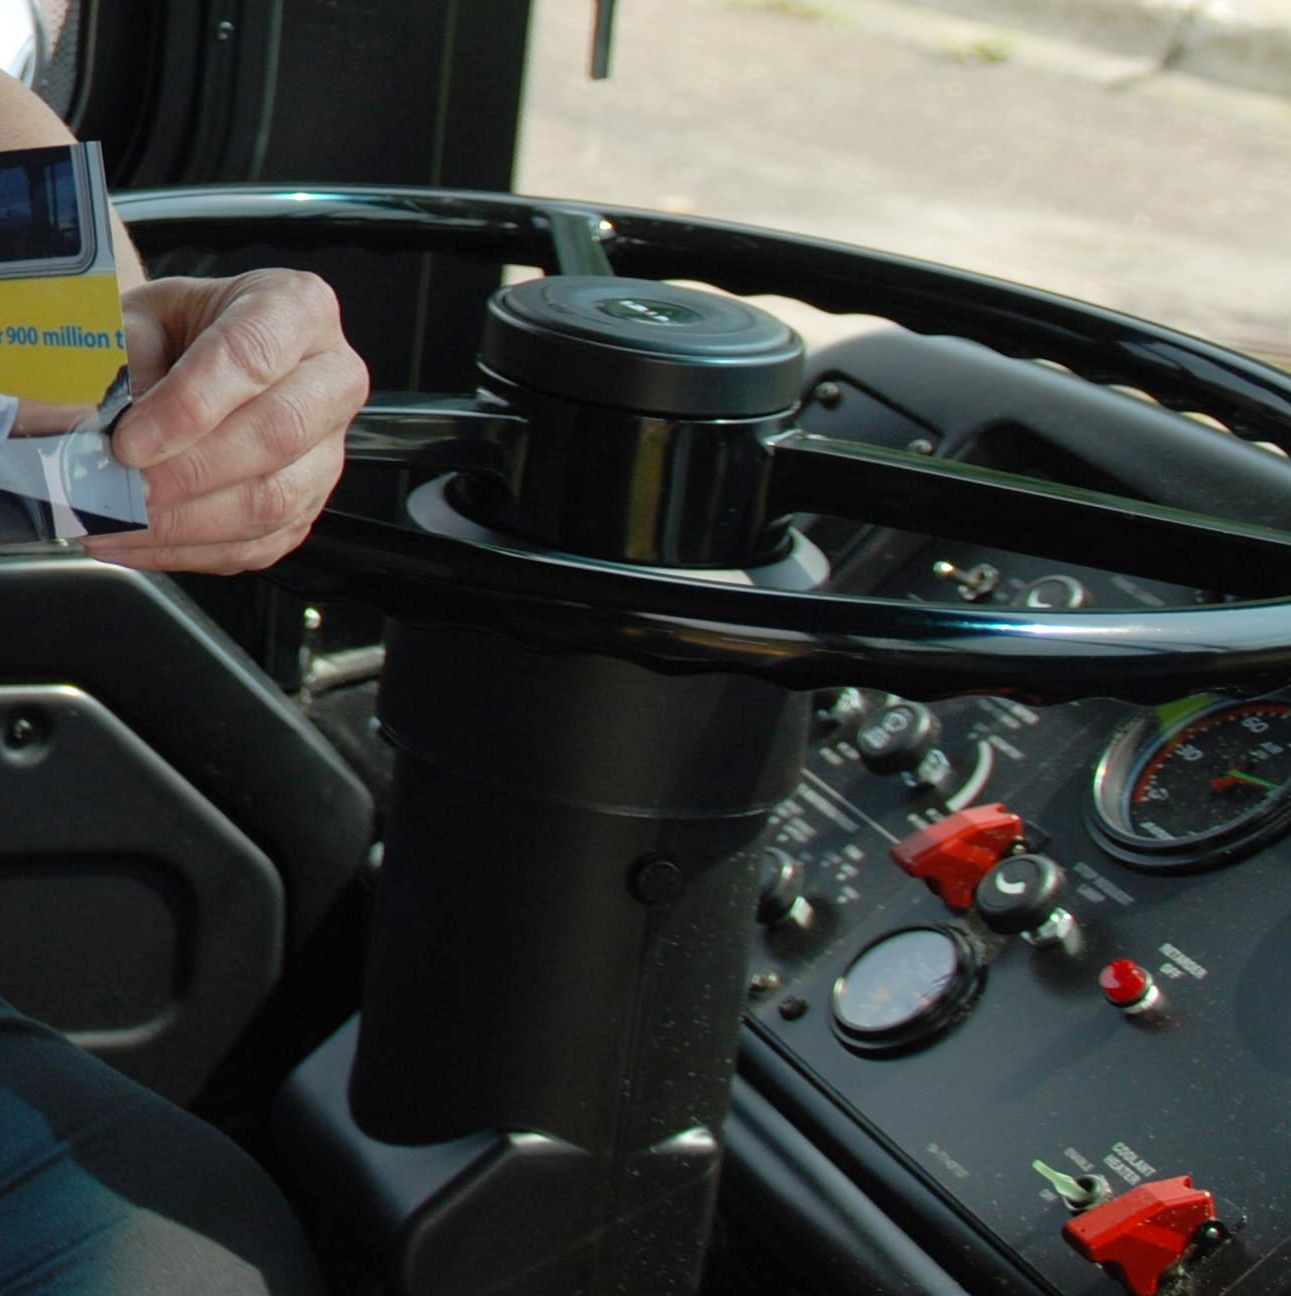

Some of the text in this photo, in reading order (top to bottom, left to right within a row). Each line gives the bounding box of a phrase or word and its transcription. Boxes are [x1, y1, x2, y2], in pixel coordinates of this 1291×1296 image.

[6, 325, 39, 346] 900
[43, 326, 110, 349] million
[1103, 1154, 1142, 1187] HEATER
[1111, 1141, 1158, 1178] COOLANT
